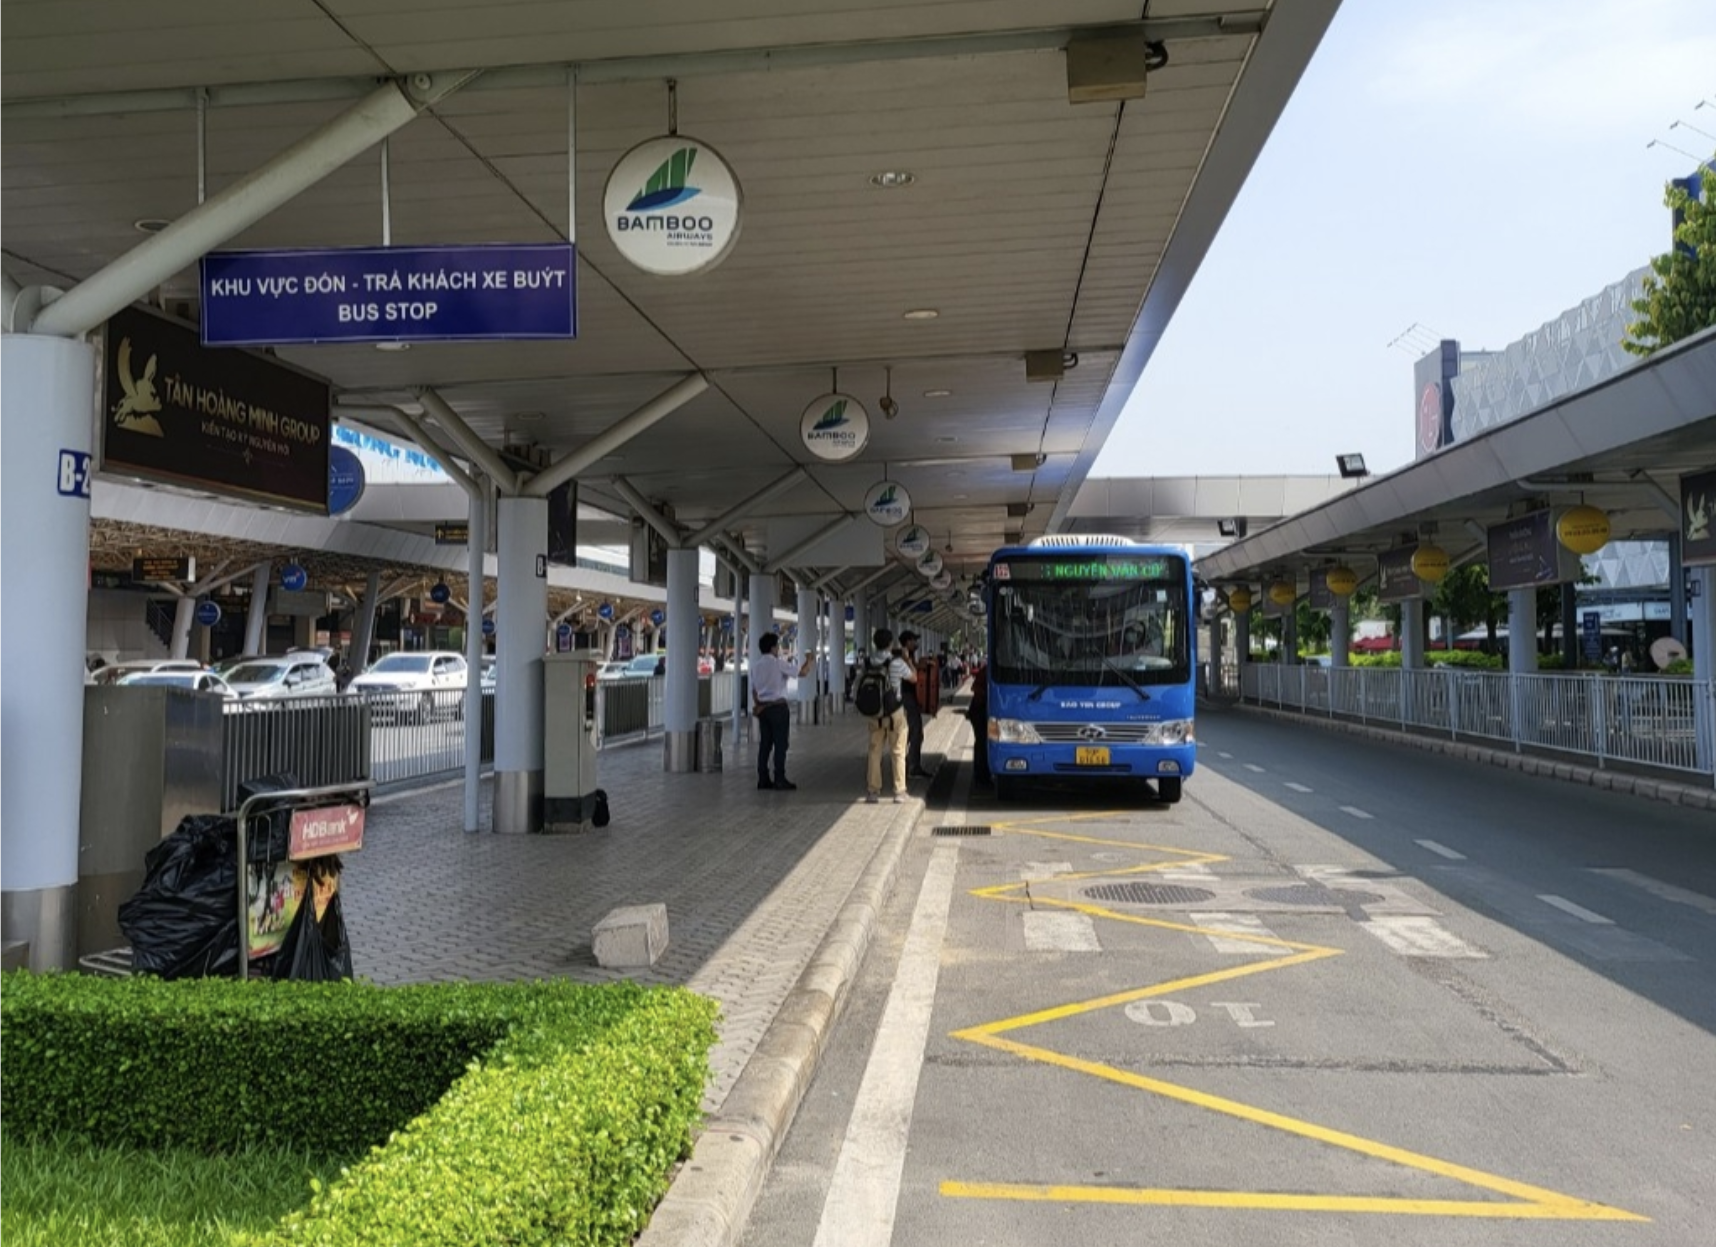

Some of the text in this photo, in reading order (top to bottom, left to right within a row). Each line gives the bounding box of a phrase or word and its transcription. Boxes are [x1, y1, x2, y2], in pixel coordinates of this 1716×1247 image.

[617, 215, 713, 231] BAMBOO
[667, 232, 713, 241] AIRWAYS
[211, 278, 251, 297] KHU
[257, 275, 299, 299] VỰC
[304, 272, 346, 294] ĐÓN
[363, 269, 402, 291] TRẢ
[407, 268, 476, 291] KHÁCH
[482, 271, 508, 290] XE
[513, 267, 566, 289] BUÝT
[338, 302, 439, 323] BUS STOP
[164, 373, 321, 445] TÂN HOÀNG MINH GROUP
